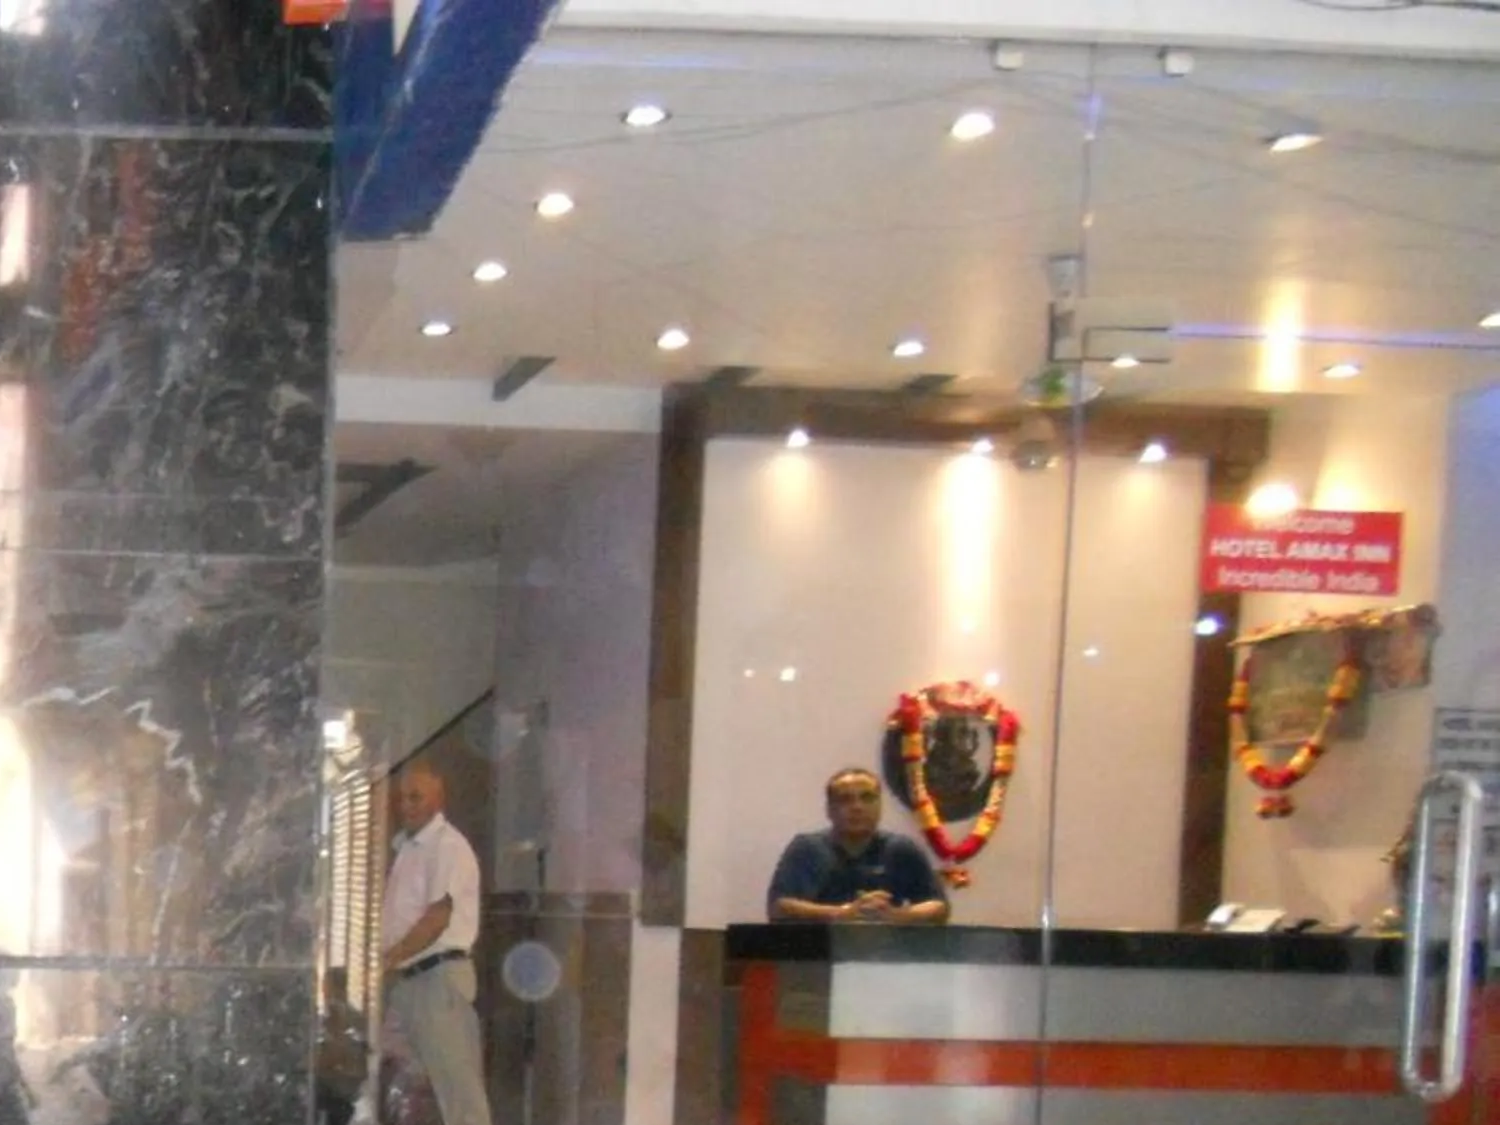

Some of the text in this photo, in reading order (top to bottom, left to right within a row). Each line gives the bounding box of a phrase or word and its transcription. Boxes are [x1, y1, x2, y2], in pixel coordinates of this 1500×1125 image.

[1210, 538, 1284, 559] HOTEL
[1286, 541, 1350, 560] AMAX
[1218, 564, 1321, 590] Incredible
